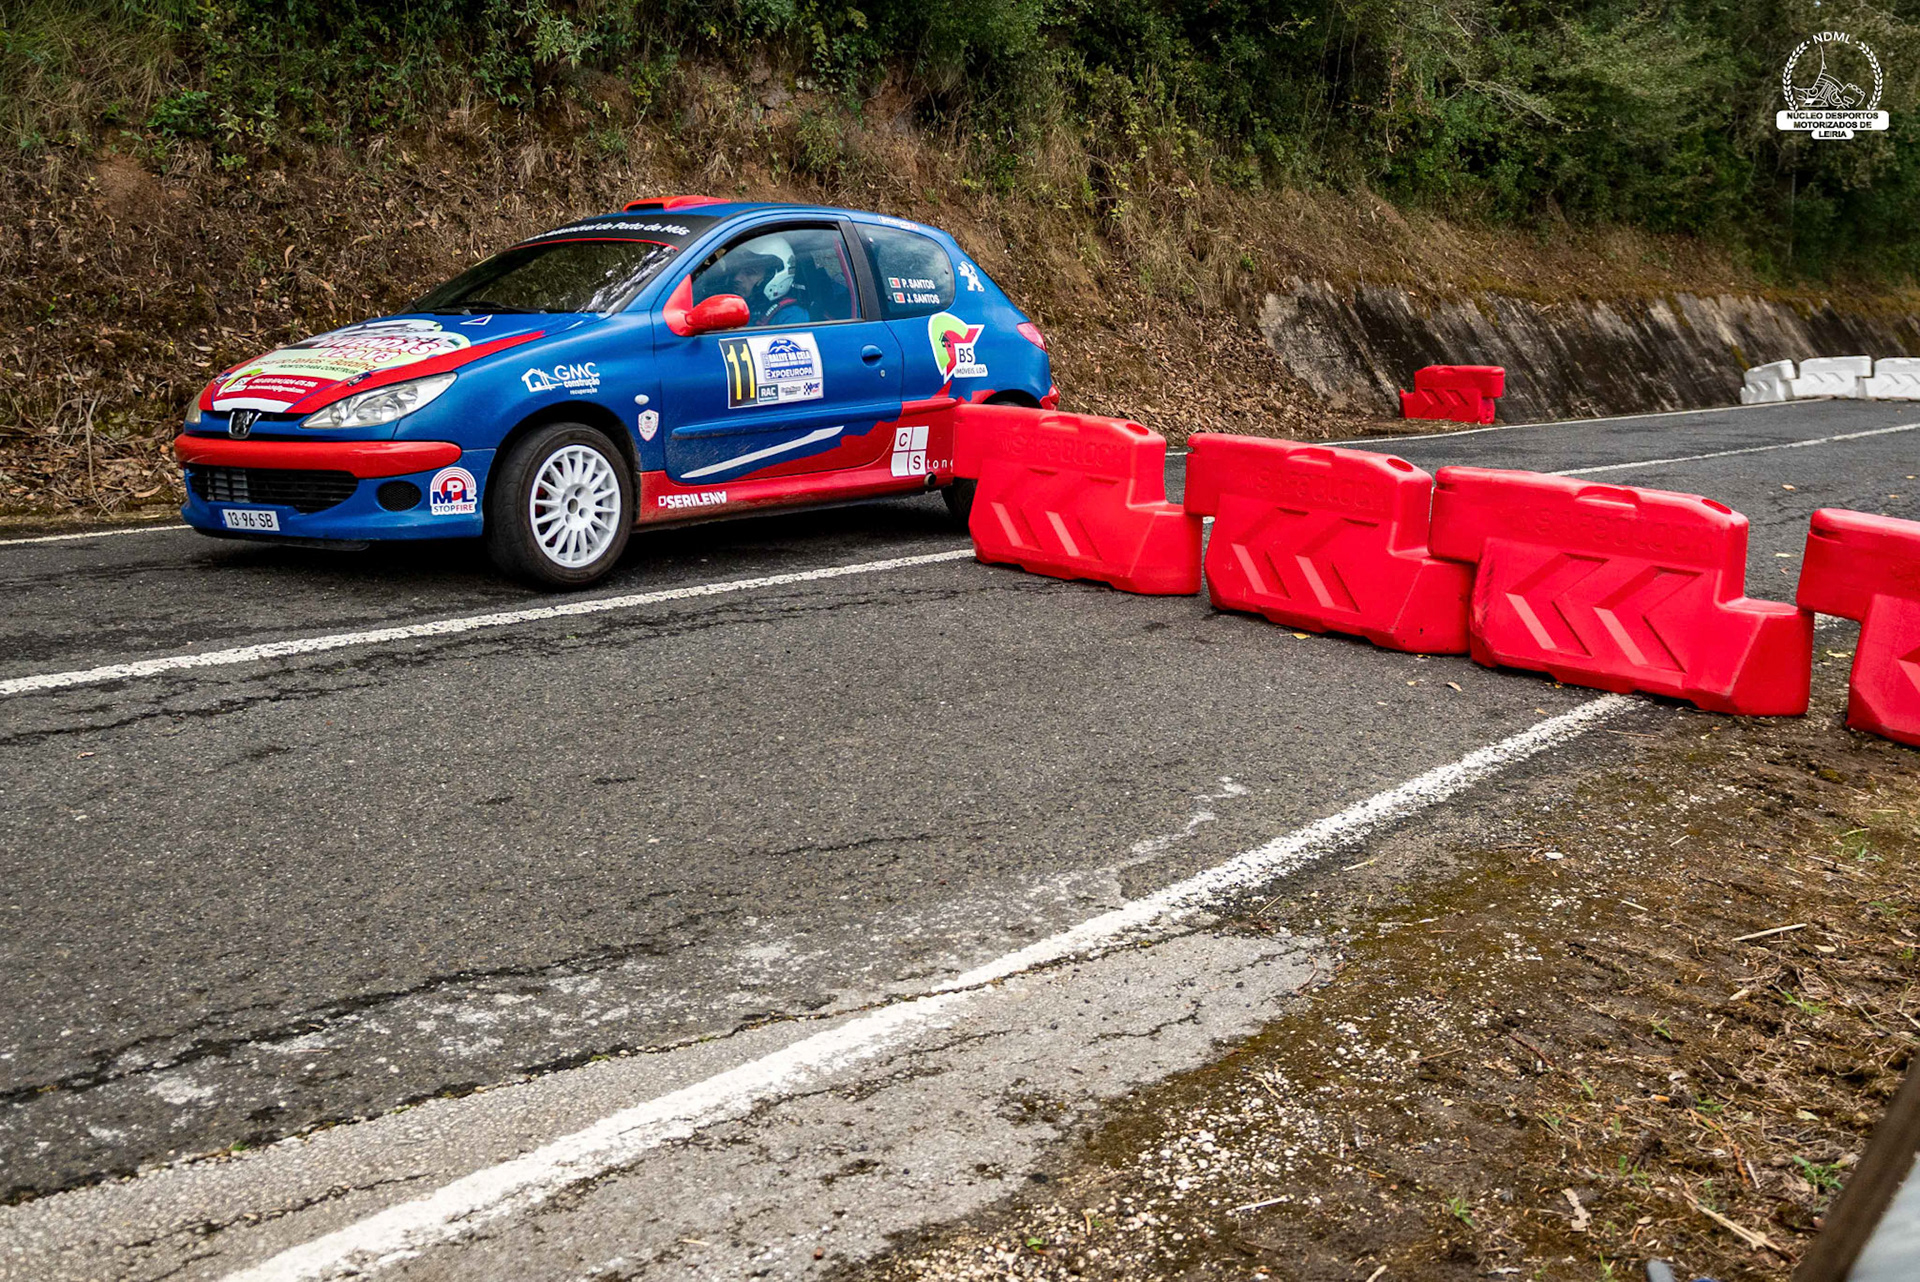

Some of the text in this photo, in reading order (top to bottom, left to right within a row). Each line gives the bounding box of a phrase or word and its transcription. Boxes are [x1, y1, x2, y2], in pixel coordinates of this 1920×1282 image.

[611, 222, 645, 230] Porto
[643, 223, 662, 231] de
[901, 278, 936, 289] P. SANTOS
[907, 293, 940, 304] J. SANTOS
[958, 347, 974, 363] BS
[554, 362, 600, 380] GMC
[727, 343, 756, 400] 11
[563, 377, 600, 388] construção
[761, 387, 776, 397] RAC
[899, 433, 908, 447] C
[434, 504, 474, 513] STOPFIRE
